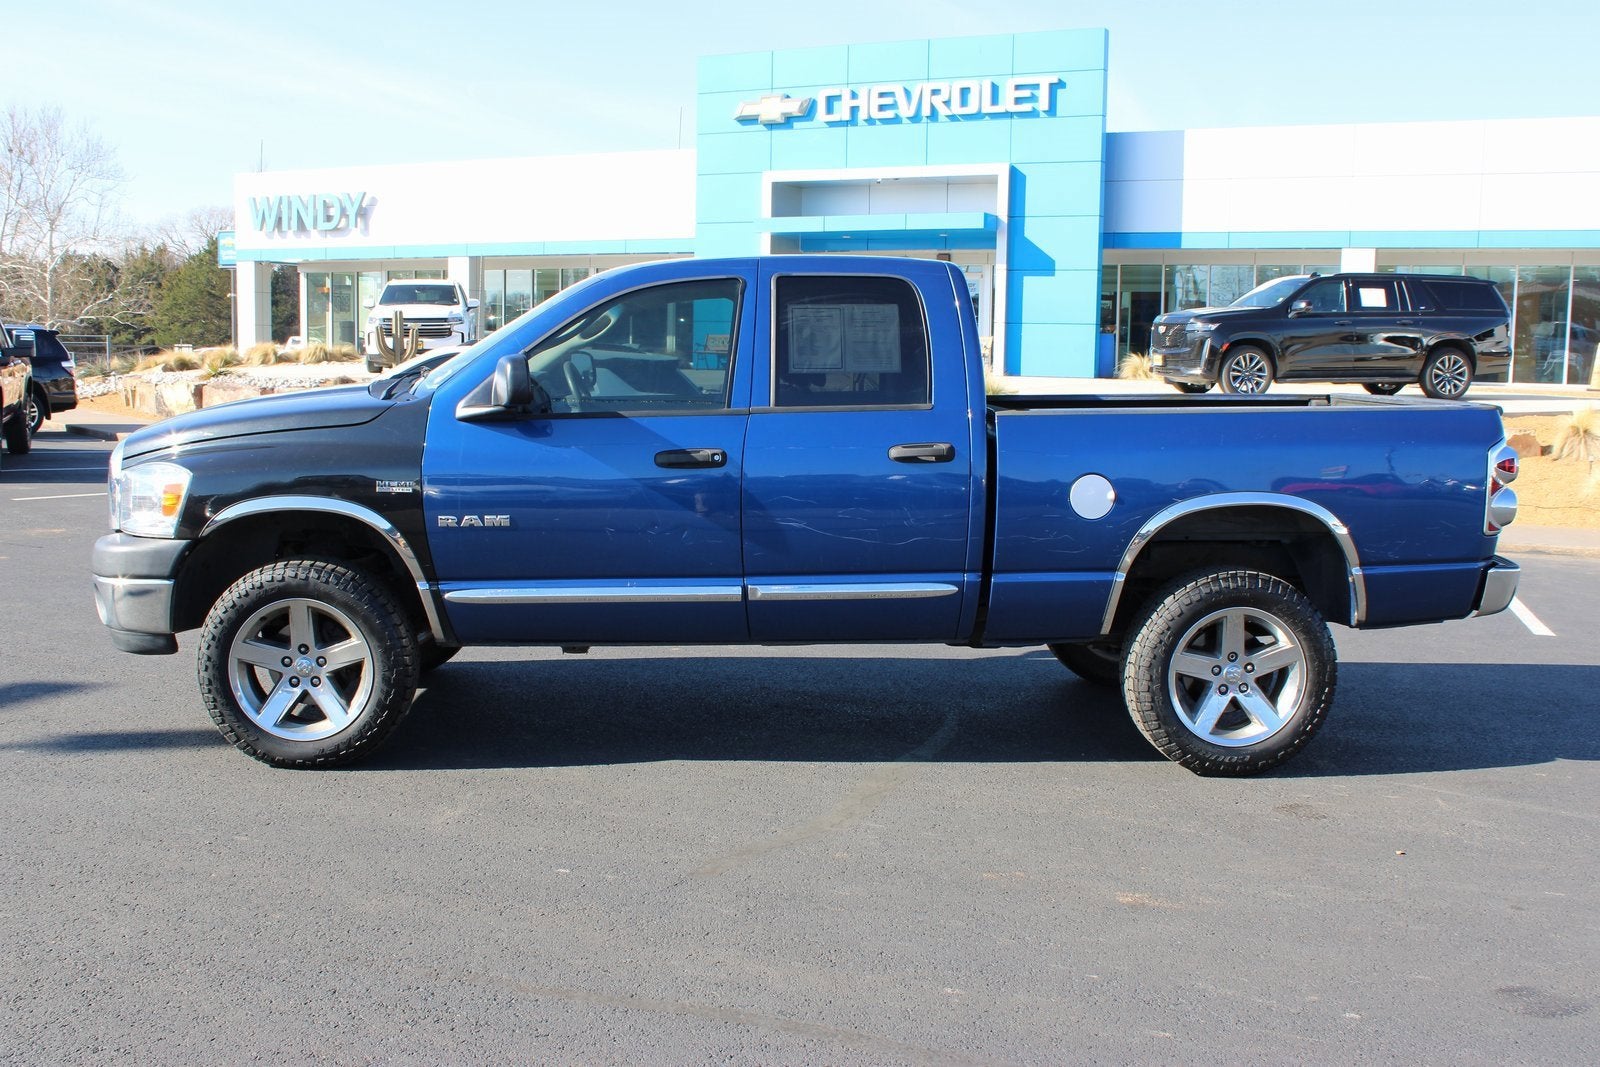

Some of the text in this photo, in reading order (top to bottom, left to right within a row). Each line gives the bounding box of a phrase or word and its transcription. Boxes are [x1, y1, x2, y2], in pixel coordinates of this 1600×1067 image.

[818, 75, 1059, 121] CHEVROLET
[248, 191, 366, 231] WINDY
[438, 515, 510, 527] RAM
